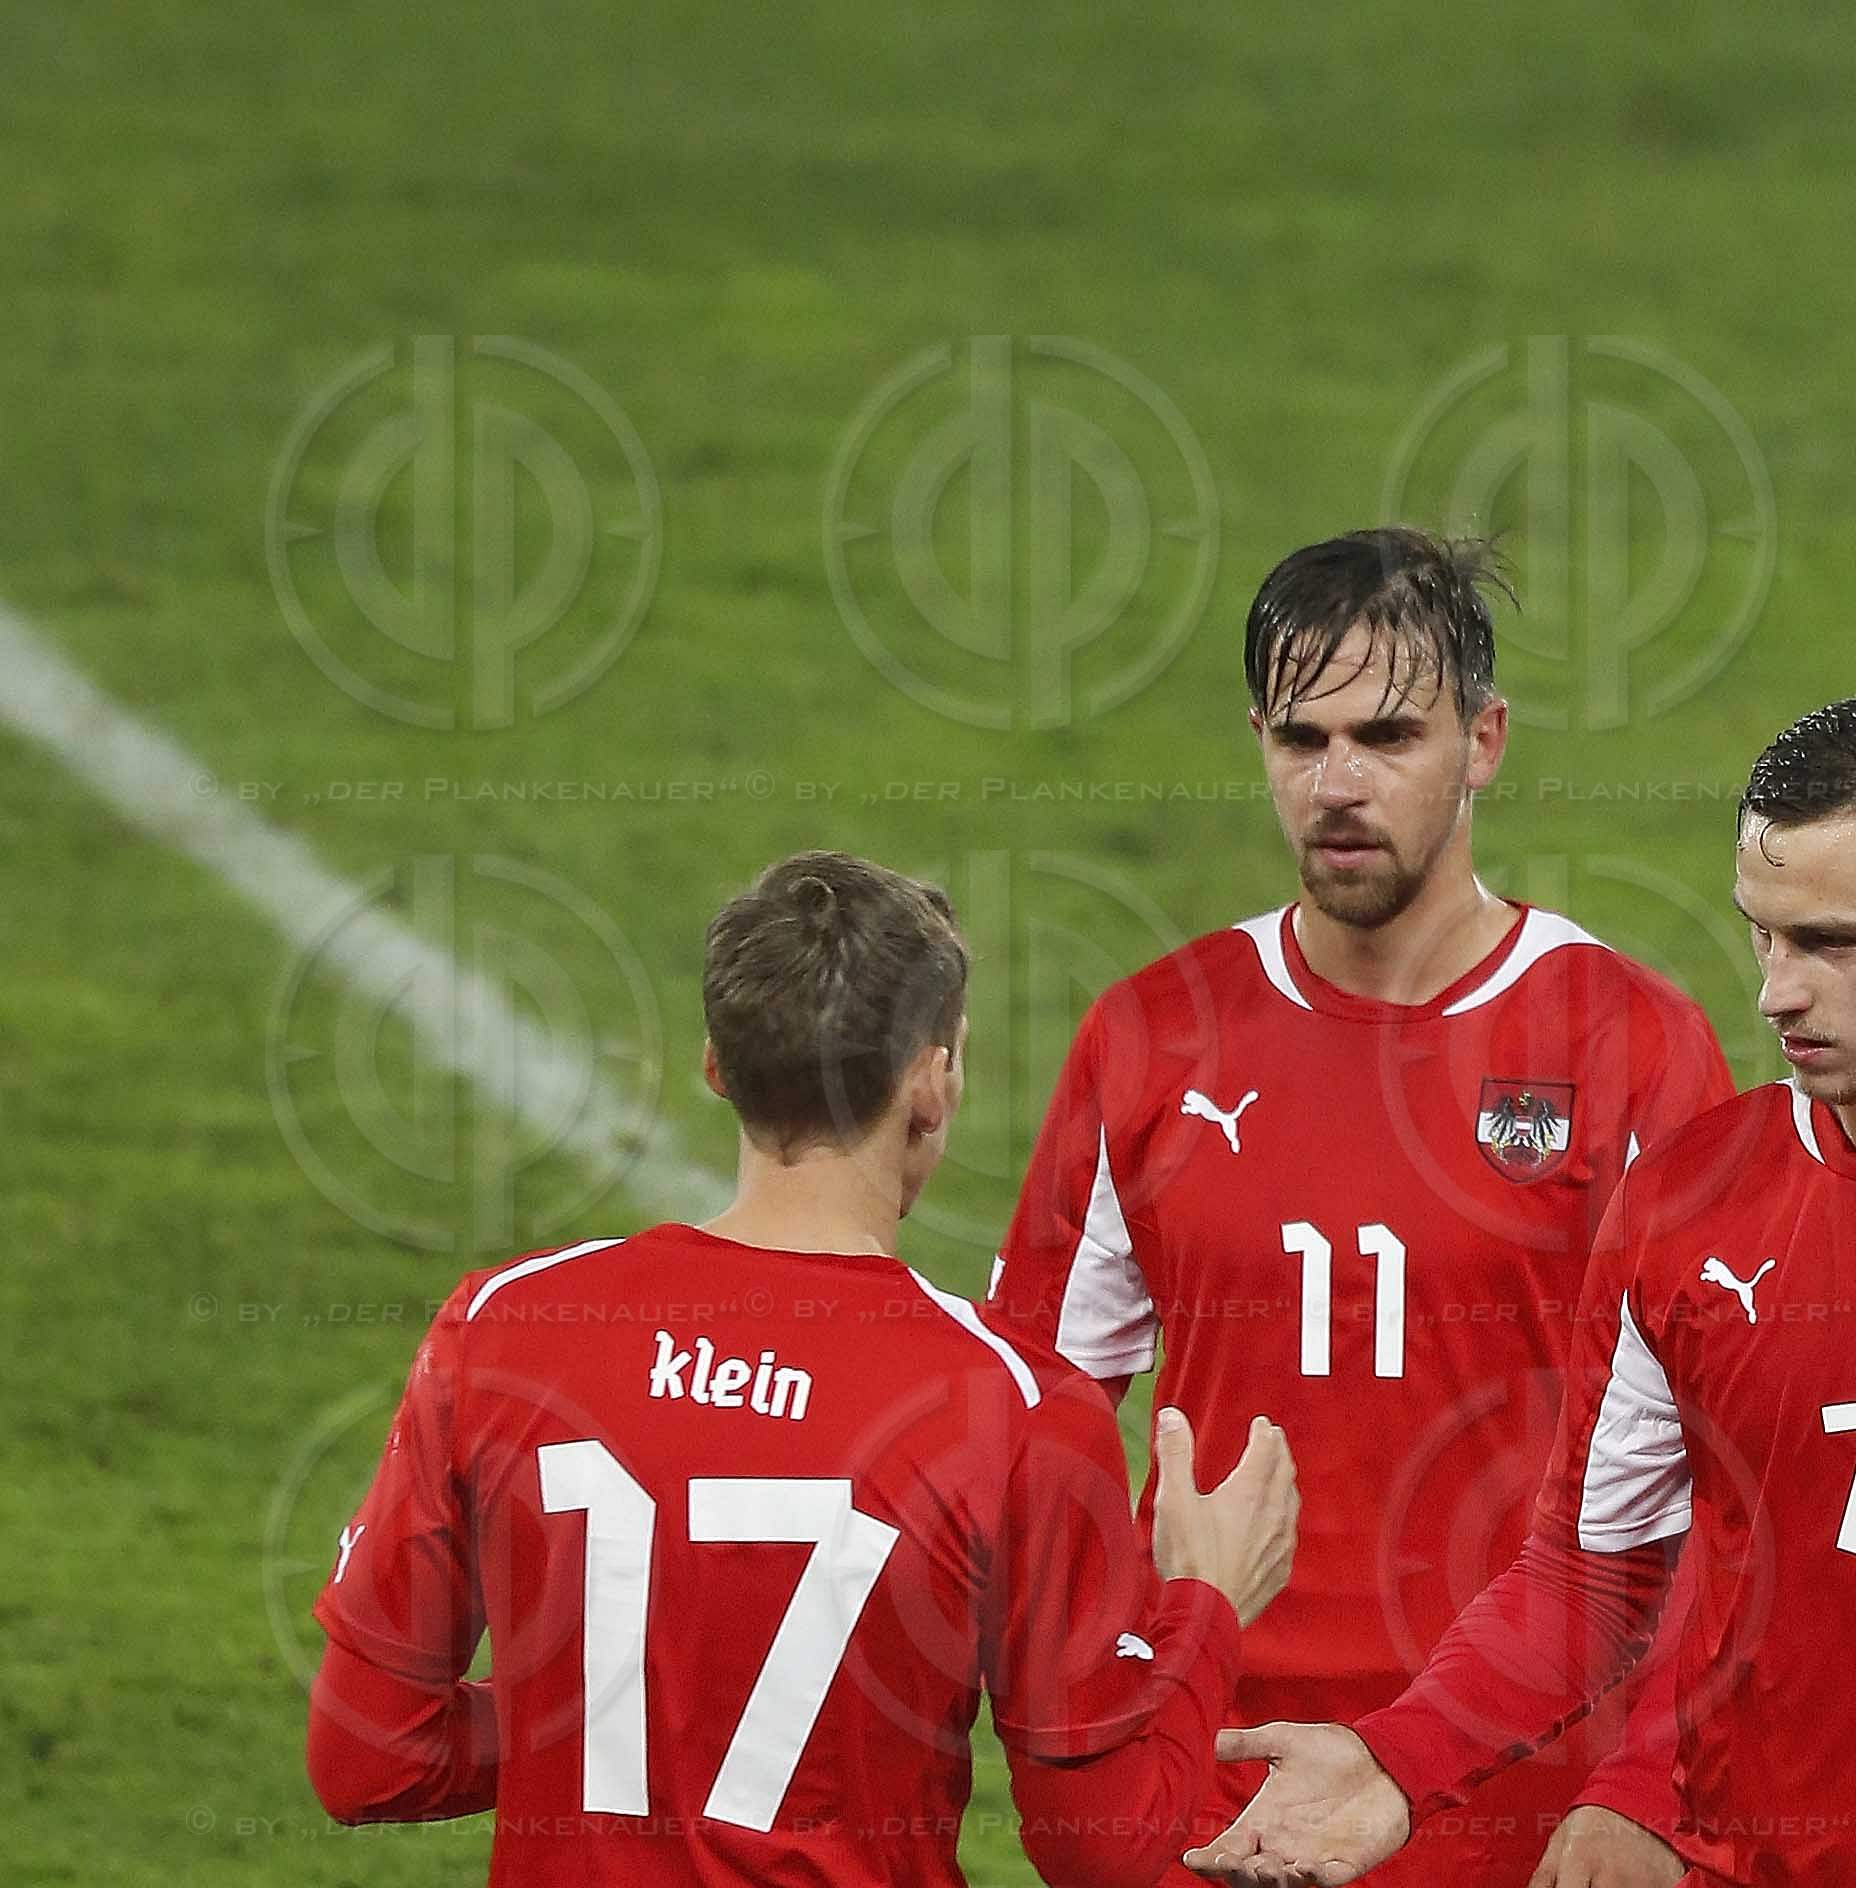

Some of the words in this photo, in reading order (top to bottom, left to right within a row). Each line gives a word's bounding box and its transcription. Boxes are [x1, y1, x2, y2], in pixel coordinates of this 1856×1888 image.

[648, 1328, 814, 1422] klein
[1281, 1221, 1407, 1379] 11
[536, 1439, 902, 1833] 17
